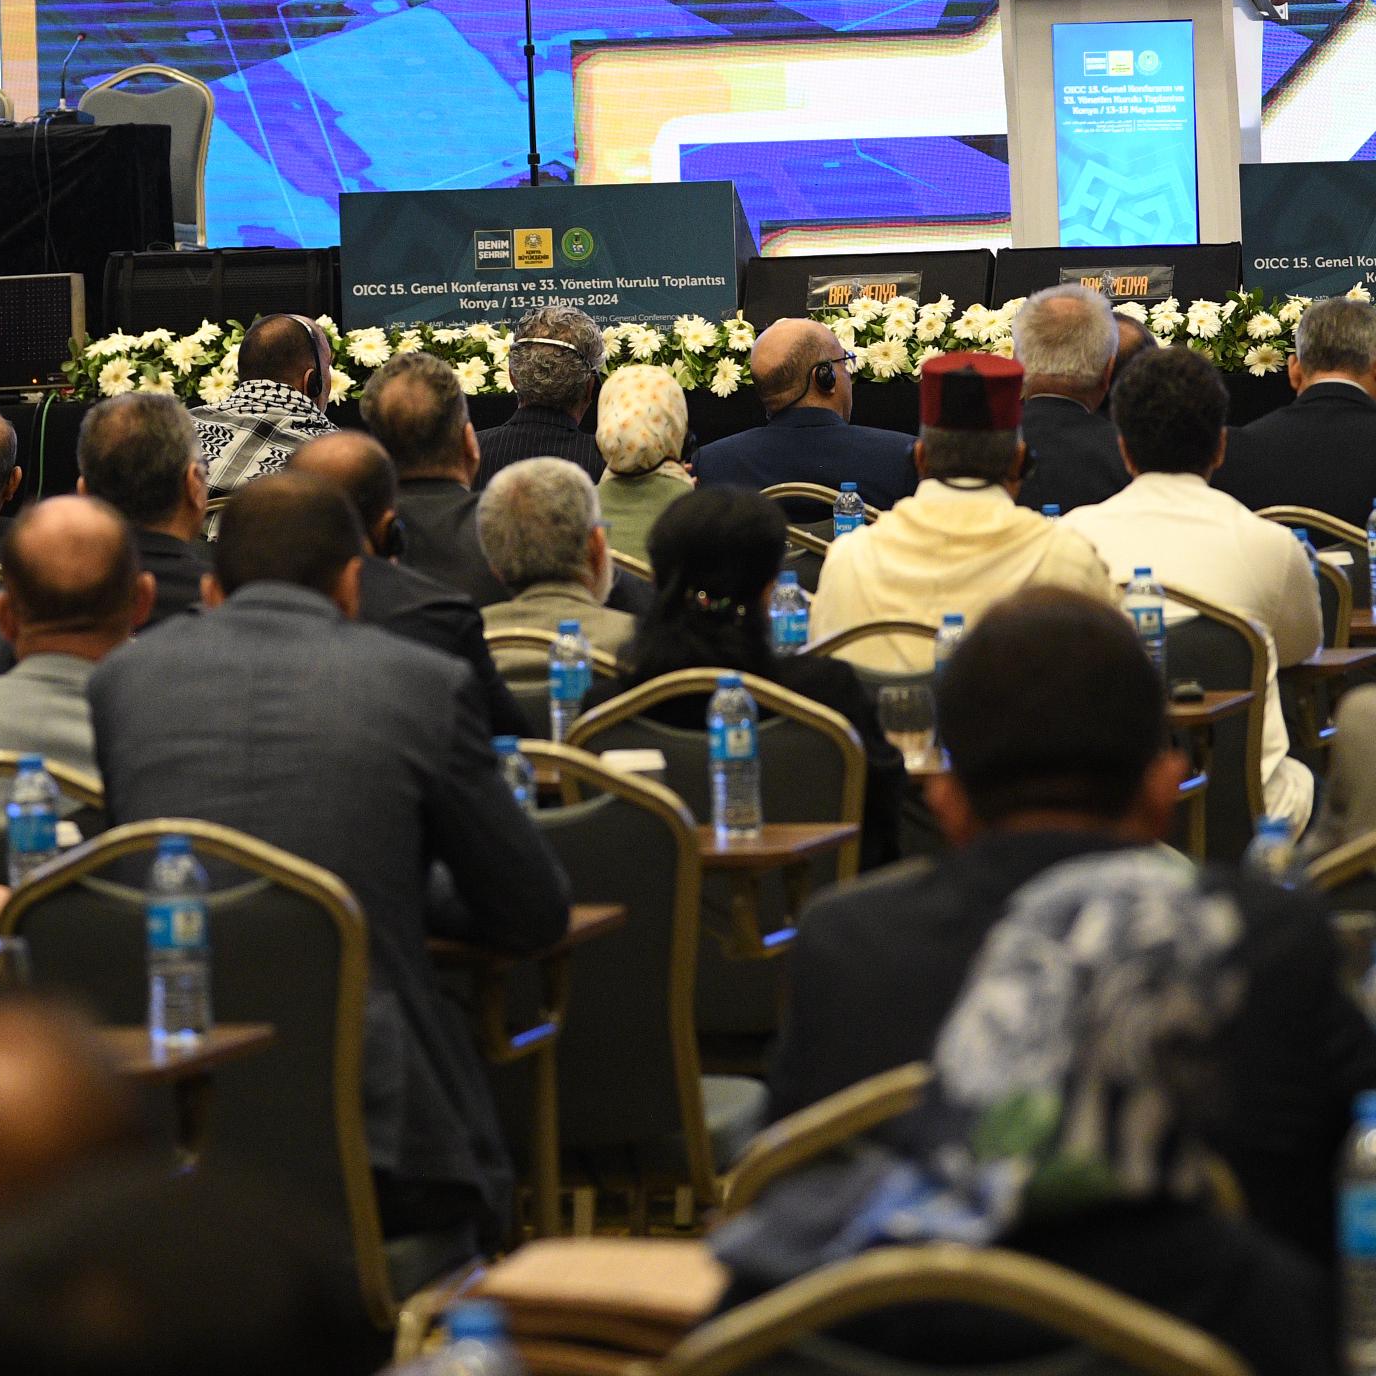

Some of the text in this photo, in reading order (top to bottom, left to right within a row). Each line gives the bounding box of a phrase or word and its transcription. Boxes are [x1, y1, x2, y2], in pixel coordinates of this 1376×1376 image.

[1254, 258, 1290, 269] OICC
[1292, 257, 1311, 268] 15.
[1315, 256, 1353, 268] Genel
[353, 275, 726, 296] OICC 15. Genel Konferansı ve 33. Yönetim Kurulu Toplantısı
[1113, 275, 1149, 295] MEDYA
[459, 294, 619, 311] Konya / 13-15 Mayıs 2024
[828, 284, 851, 305] BAY
[609, 314, 637, 322] General
